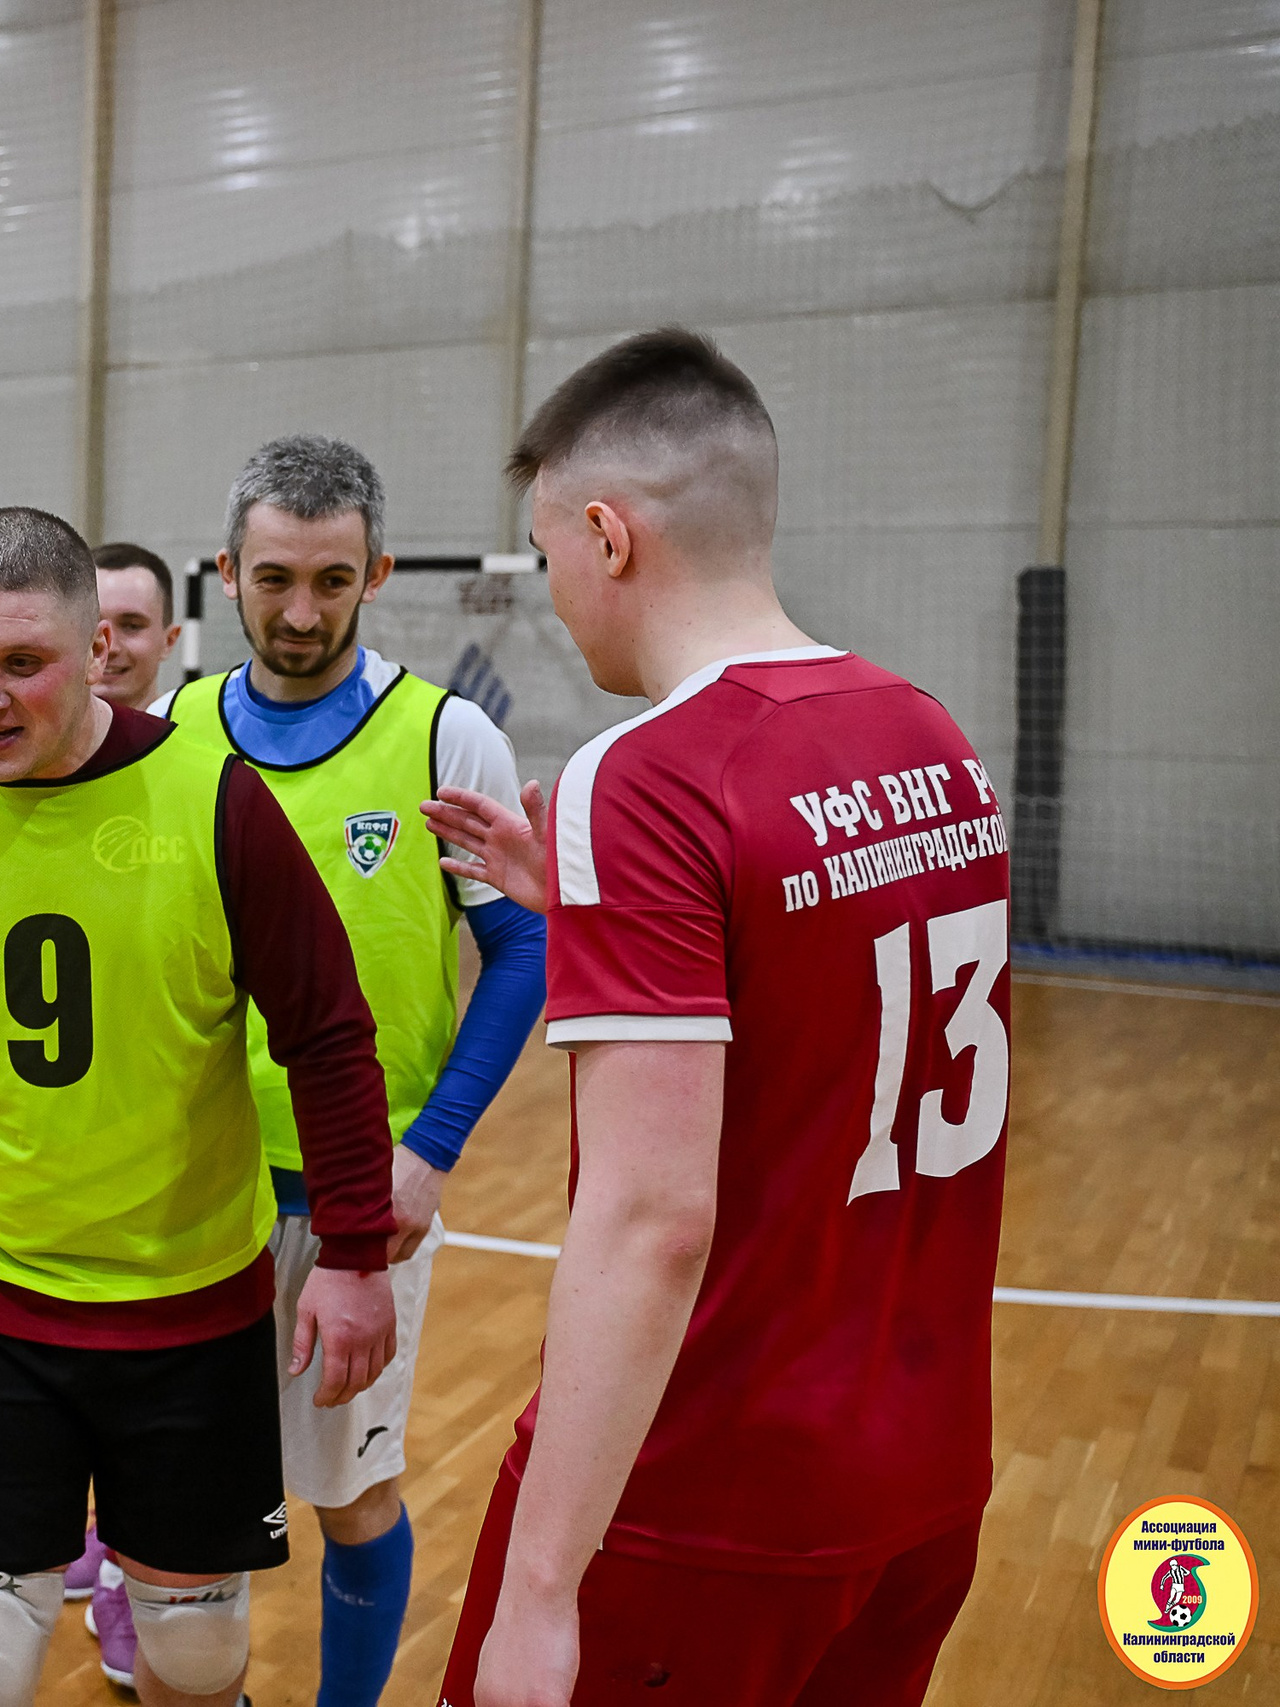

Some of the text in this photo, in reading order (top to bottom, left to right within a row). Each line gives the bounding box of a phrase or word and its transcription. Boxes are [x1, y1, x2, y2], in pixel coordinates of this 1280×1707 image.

[789, 759, 999, 847] УФС ВНГ Р
[3, 912, 94, 1088] 9
[846, 898, 1010, 1207] 13
